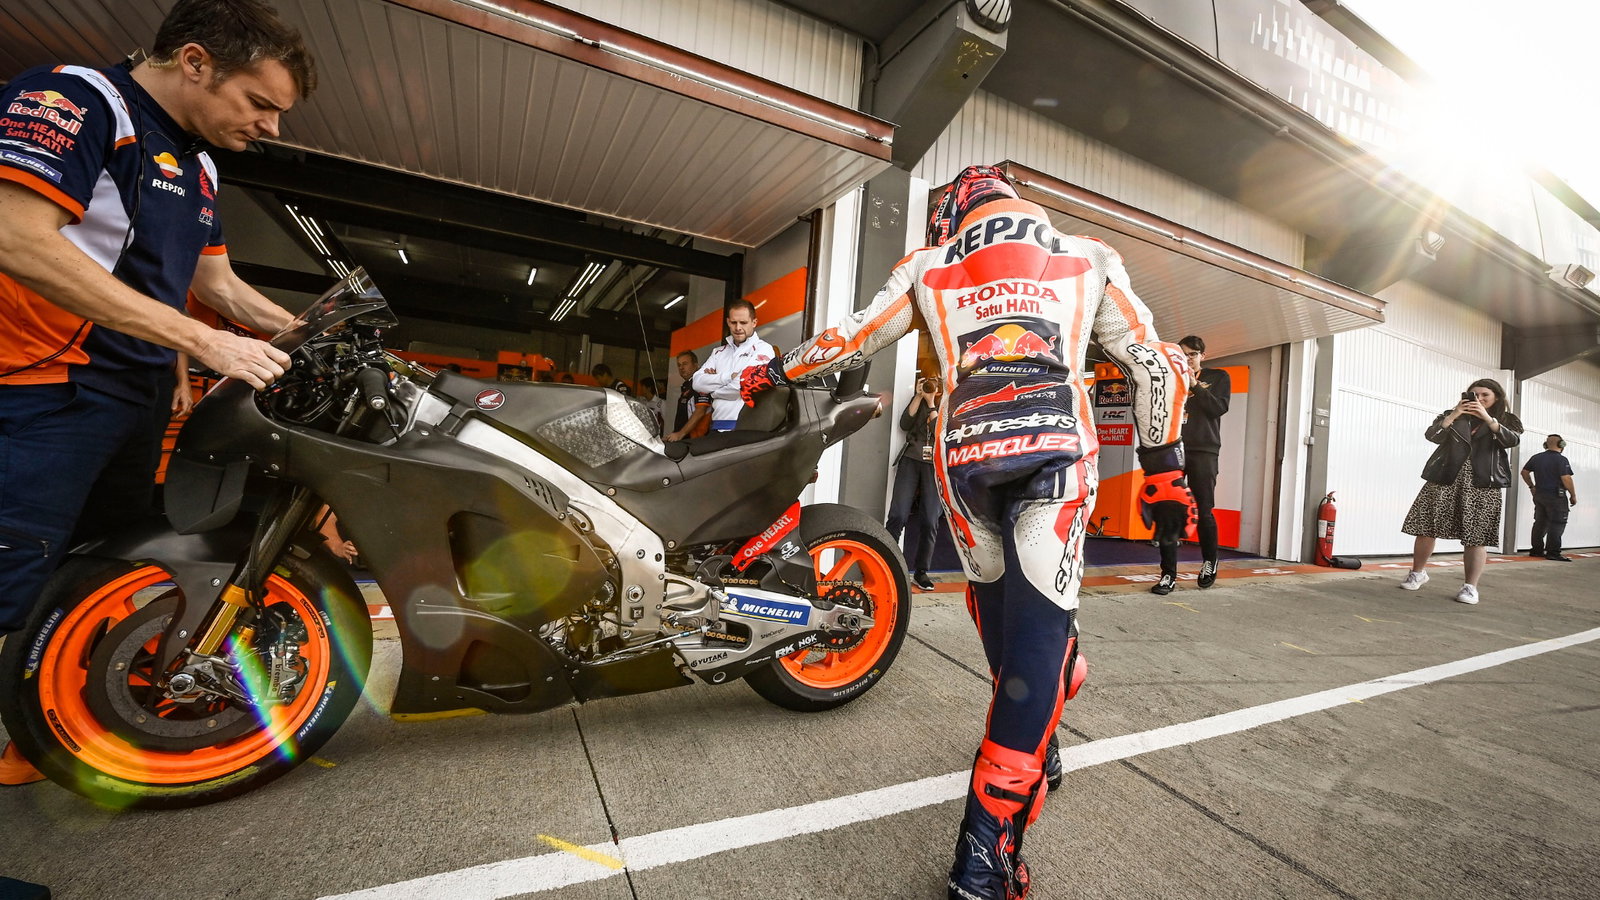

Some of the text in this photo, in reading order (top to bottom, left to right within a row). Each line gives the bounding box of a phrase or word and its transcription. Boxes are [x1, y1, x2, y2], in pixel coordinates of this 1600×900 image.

[5, 127, 30, 138] Satu
[7, 103, 82, 135] Red Bull
[0, 117, 75, 151] One HEART.
[5, 153, 56, 177] MICHELIN
[938, 219, 951, 245] Bull
[944, 216, 1069, 265] REPSOL
[957, 282, 1061, 310] HONDA
[975, 298, 1043, 320] Satu HATI.
[990, 366, 1041, 374] MICHELIN
[1127, 343, 1168, 444] alpinestars
[945, 412, 1077, 443] alpinestars
[1102, 410, 1126, 419] HRC
[948, 433, 1080, 466] MARQUEZ
[744, 514, 793, 557] One HEART.
[741, 603, 803, 619] MICHELIN
[30, 611, 60, 660] MICHELIN
[798, 634, 817, 648] NGK
[698, 652, 728, 665] YUTAKA
[775, 643, 795, 659] RK
[272, 663, 283, 692] brembo
[299, 696, 331, 738] MICHELIN
